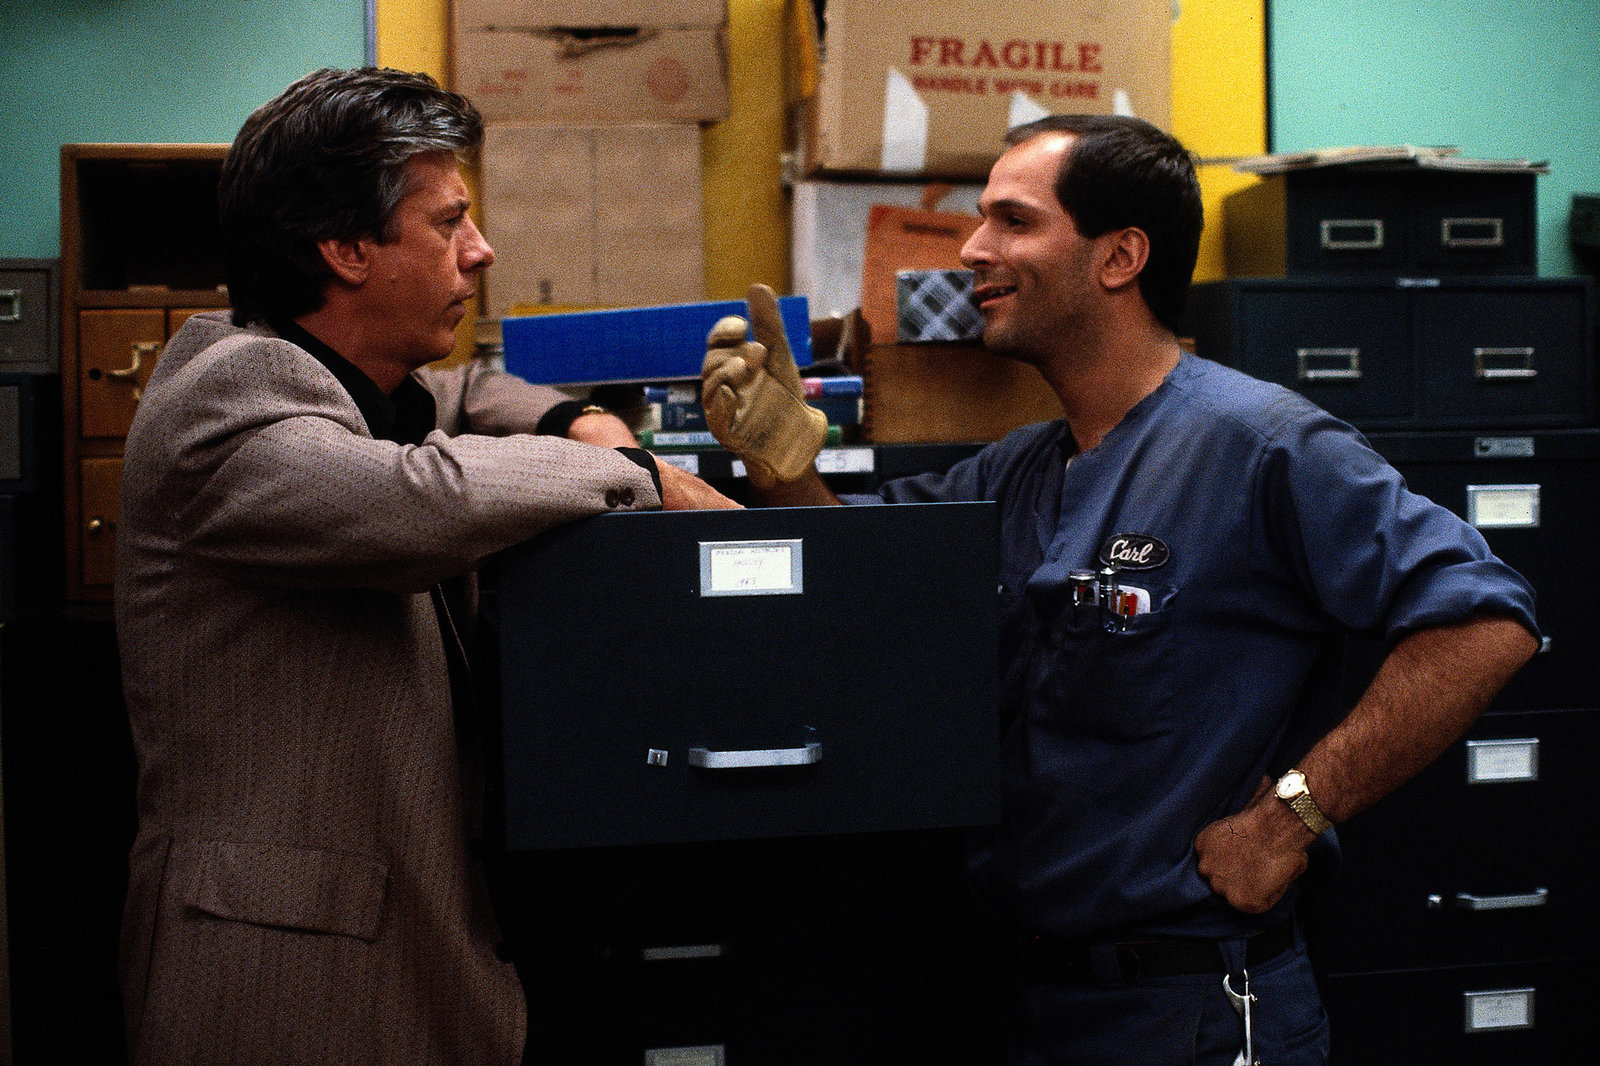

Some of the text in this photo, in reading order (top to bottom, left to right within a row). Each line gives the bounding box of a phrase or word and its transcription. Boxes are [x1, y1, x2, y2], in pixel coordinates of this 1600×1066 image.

[910, 36, 1102, 73] FRAGILE
[913, 76, 986, 95] HANDLE
[1049, 81, 1098, 98] CARE
[1110, 539, 1153, 564] Carl
